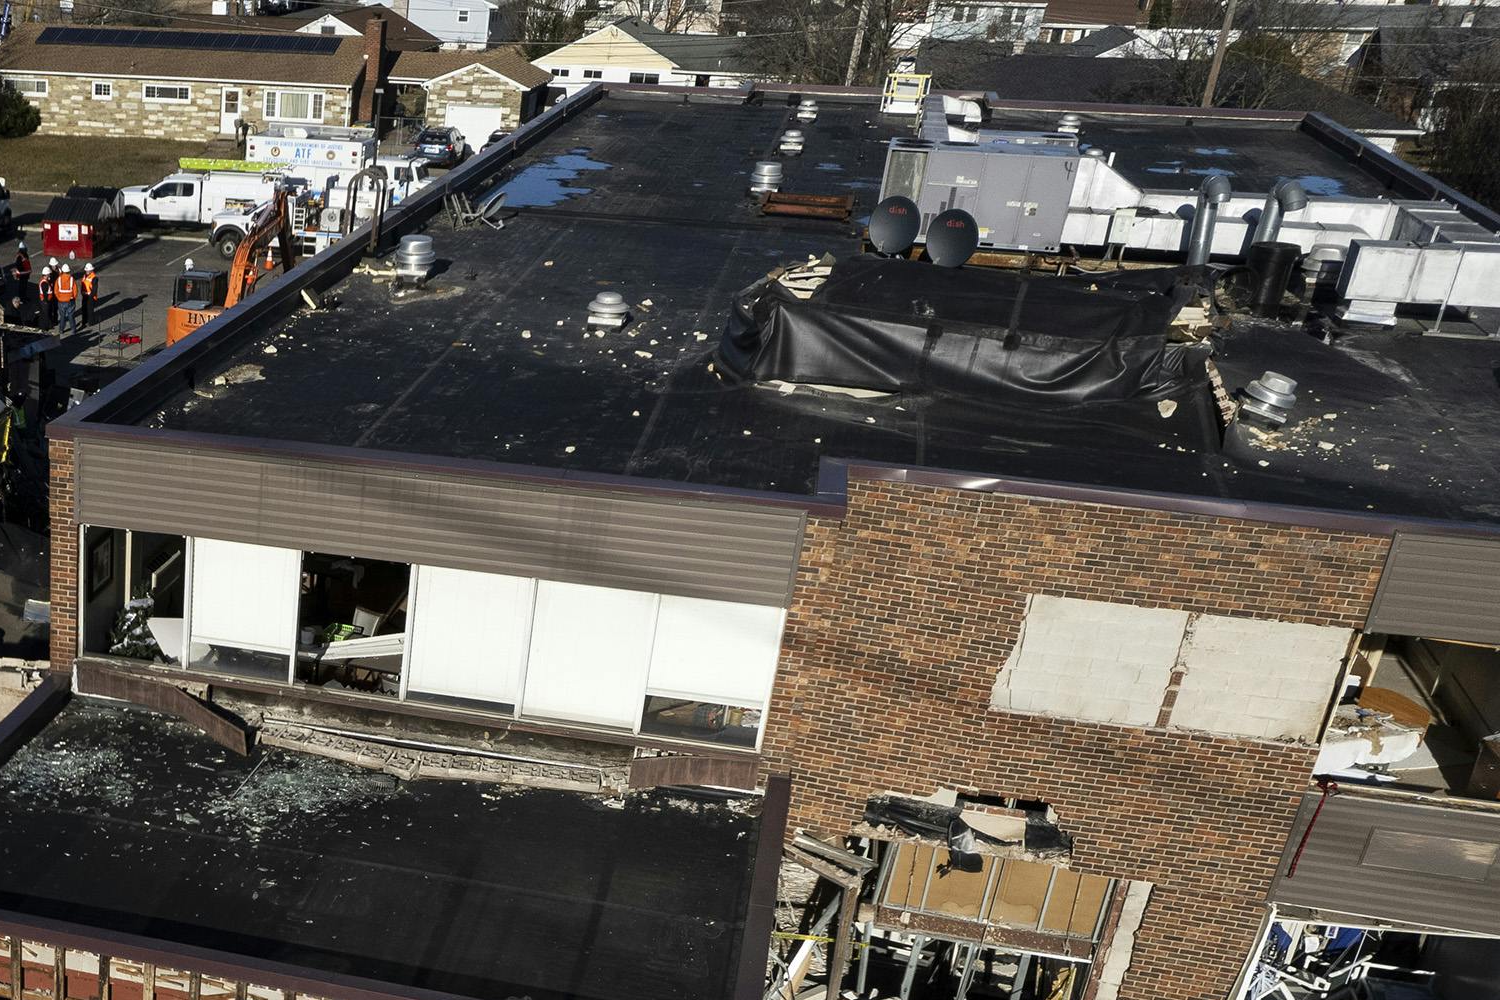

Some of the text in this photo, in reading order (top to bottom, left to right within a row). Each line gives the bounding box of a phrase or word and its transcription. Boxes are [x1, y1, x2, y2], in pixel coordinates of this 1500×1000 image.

[294, 148, 312, 158] ATF
[1065, 161, 1074, 180] 4
[888, 205, 908, 215] dish
[946, 219, 965, 229] dish
[188, 312, 219, 325] HM
